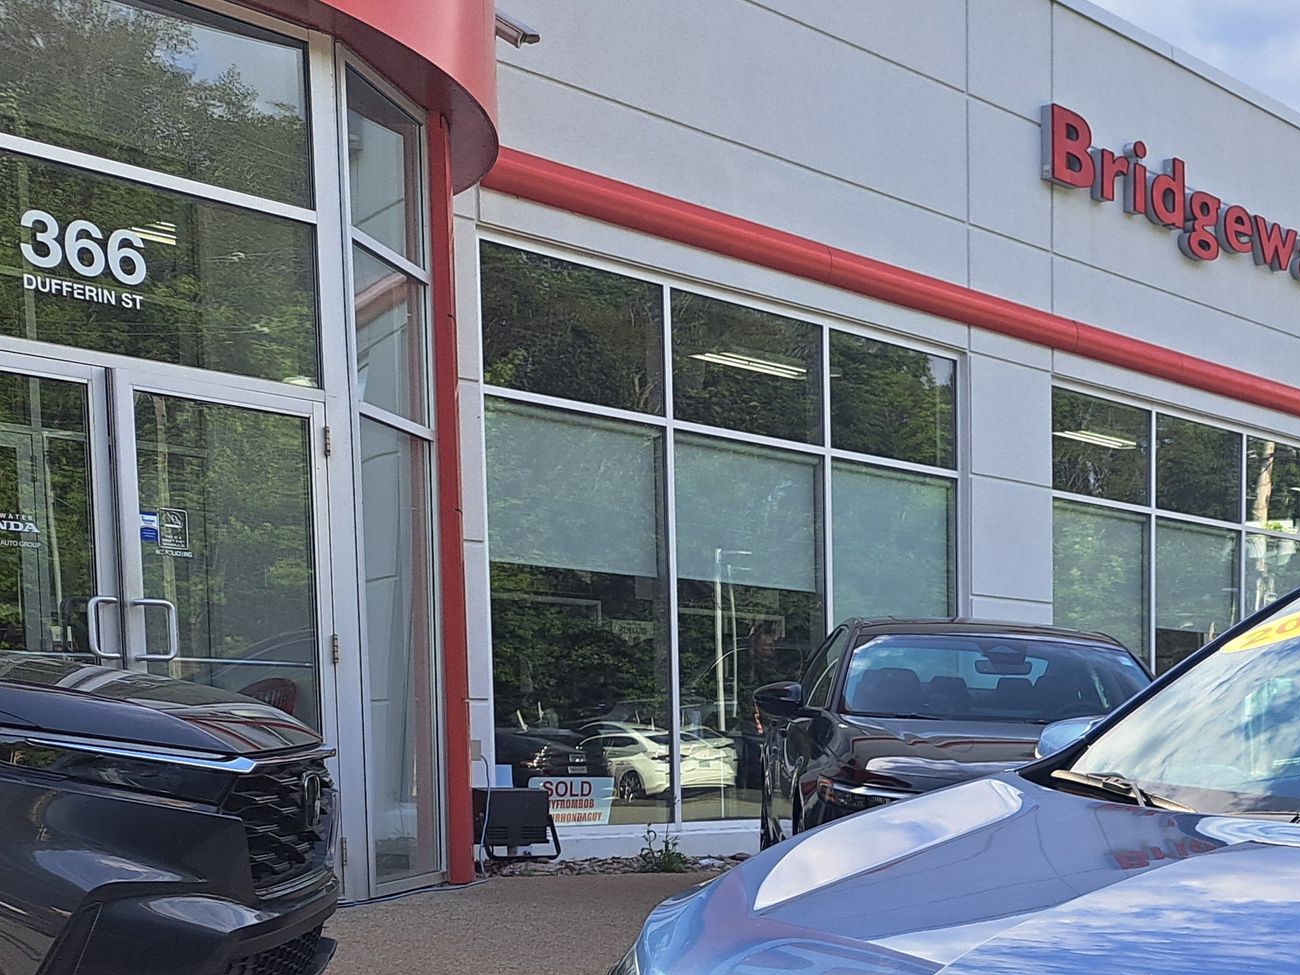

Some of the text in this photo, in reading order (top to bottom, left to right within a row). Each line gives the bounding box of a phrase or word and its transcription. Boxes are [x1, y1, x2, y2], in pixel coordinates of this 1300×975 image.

[20, 209, 147, 285] 366
[23, 273, 144, 310] DUFFERIN ST
[543, 781, 592, 797] SOLD
[549, 799, 594, 809] YFROMBOB
[553, 812, 602, 823] RHONDAGUY
